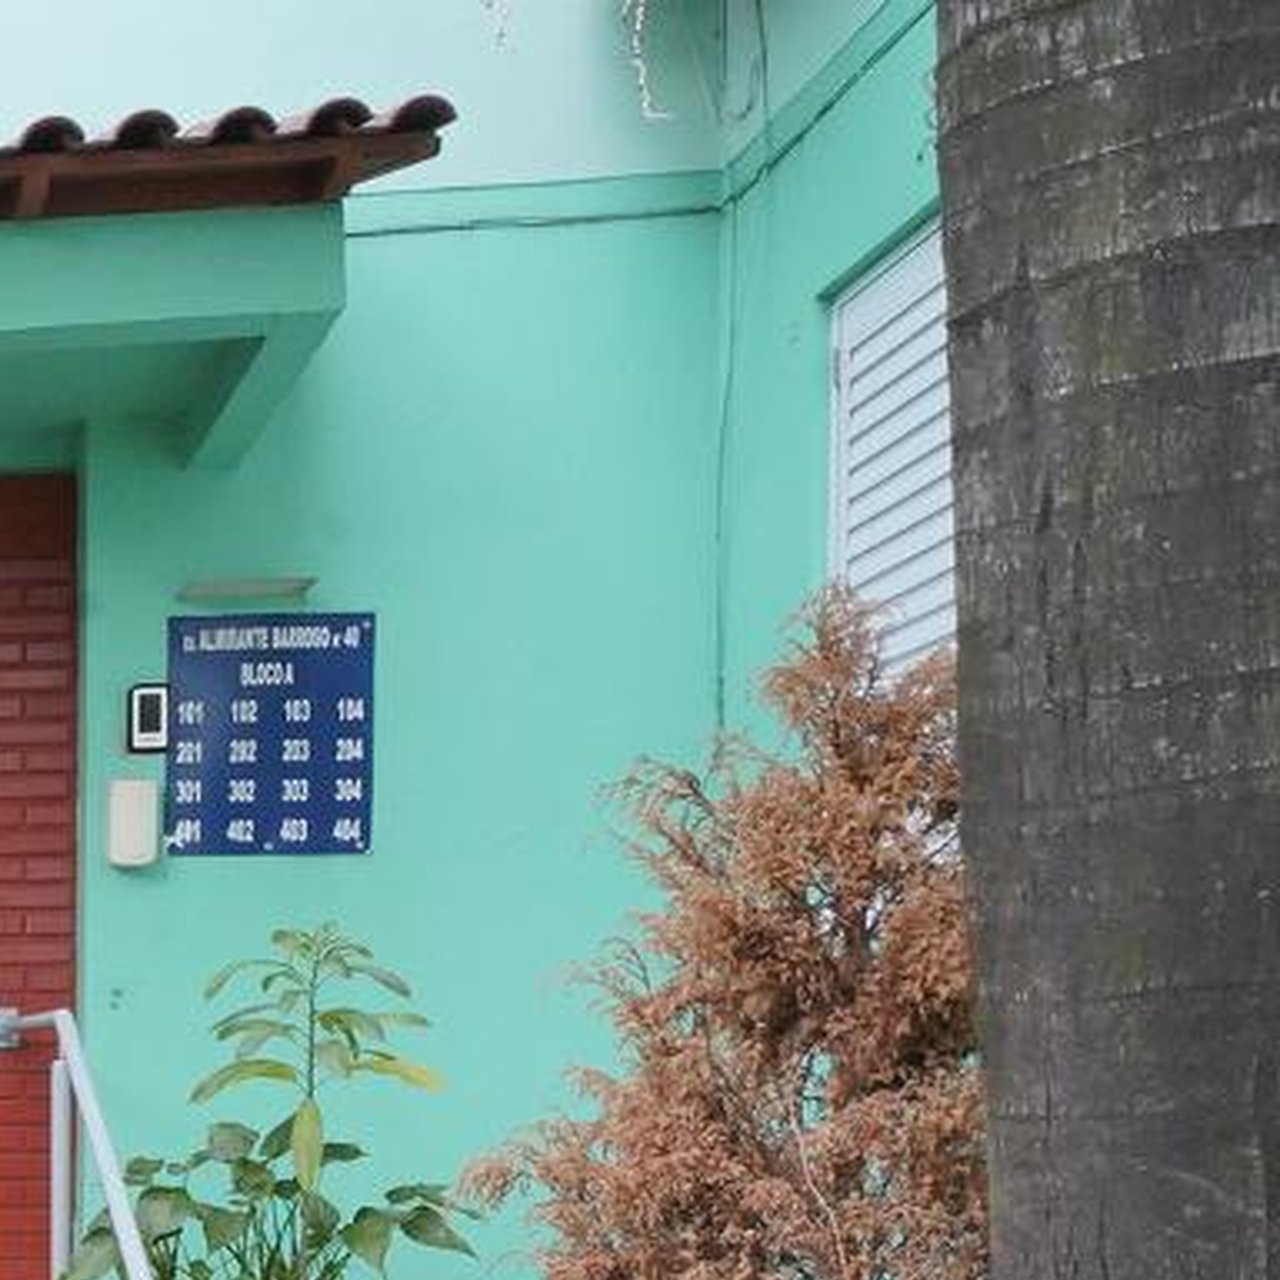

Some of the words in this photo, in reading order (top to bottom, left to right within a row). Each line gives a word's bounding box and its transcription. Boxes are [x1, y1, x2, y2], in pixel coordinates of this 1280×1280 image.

[241, 662, 283, 686] BLOCO
[284, 663, 294, 685] A
[178, 700, 204, 725] 101
[231, 699, 258, 723] 102
[284, 698, 311, 722] 103
[337, 698, 364, 722] 104
[175, 741, 202, 764] 201
[229, 739, 257, 763] 202
[282, 738, 310, 762] 203
[336, 738, 364, 762] 204
[175, 779, 202, 803] 301
[228, 779, 256, 802] 302
[282, 778, 309, 801] 303
[335, 778, 362, 801] 304
[227, 818, 255, 842] 402
[279, 818, 308, 842] 403
[333, 818, 361, 841] 404
